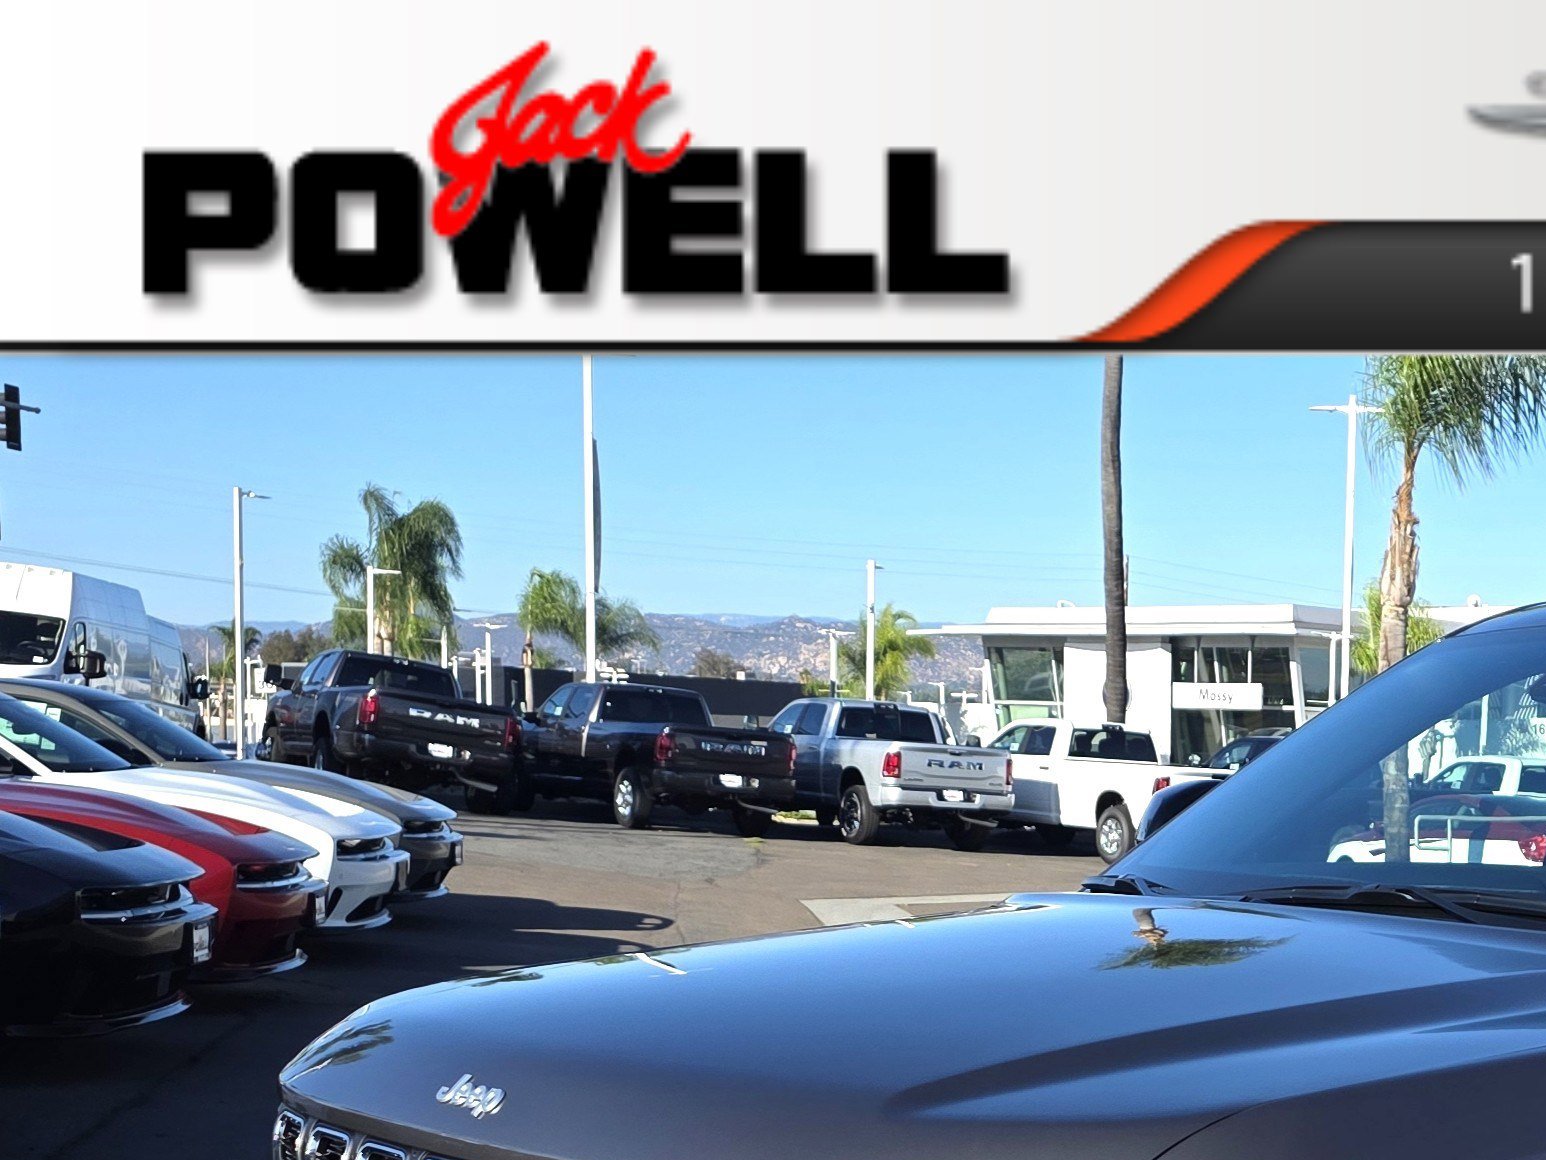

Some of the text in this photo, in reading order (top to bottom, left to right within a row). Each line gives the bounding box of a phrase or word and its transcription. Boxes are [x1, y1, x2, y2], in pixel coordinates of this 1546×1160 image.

[1199, 688, 1232, 704] Mossy
[926, 758, 984, 771] RAM
[435, 1073, 506, 1119] Jeep
